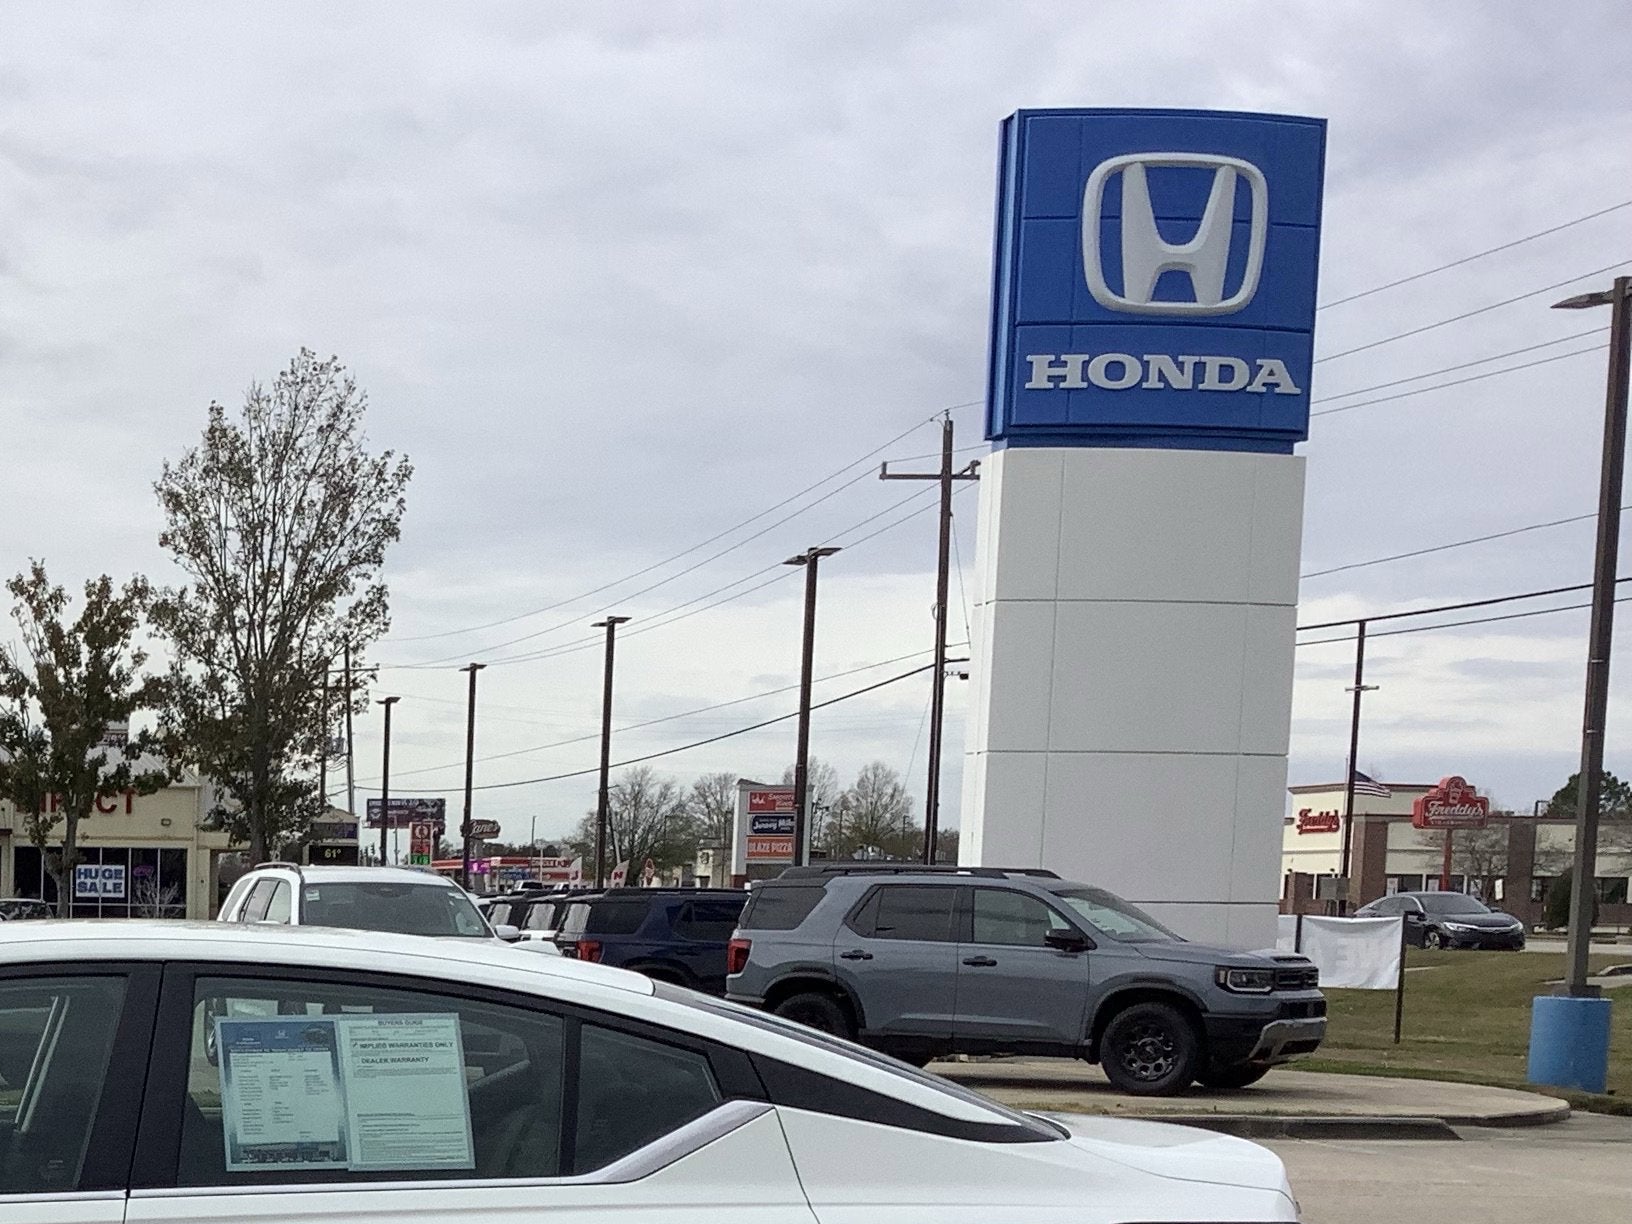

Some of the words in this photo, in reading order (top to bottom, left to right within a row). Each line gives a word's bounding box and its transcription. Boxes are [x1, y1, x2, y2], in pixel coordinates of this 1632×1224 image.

[1024, 353, 1302, 395] HONDA
[17, 788, 136, 815] IRCT
[1426, 802, 1484, 817] Freddy's
[76, 867, 123, 880] HUGE
[77, 881, 123, 894] SALE
